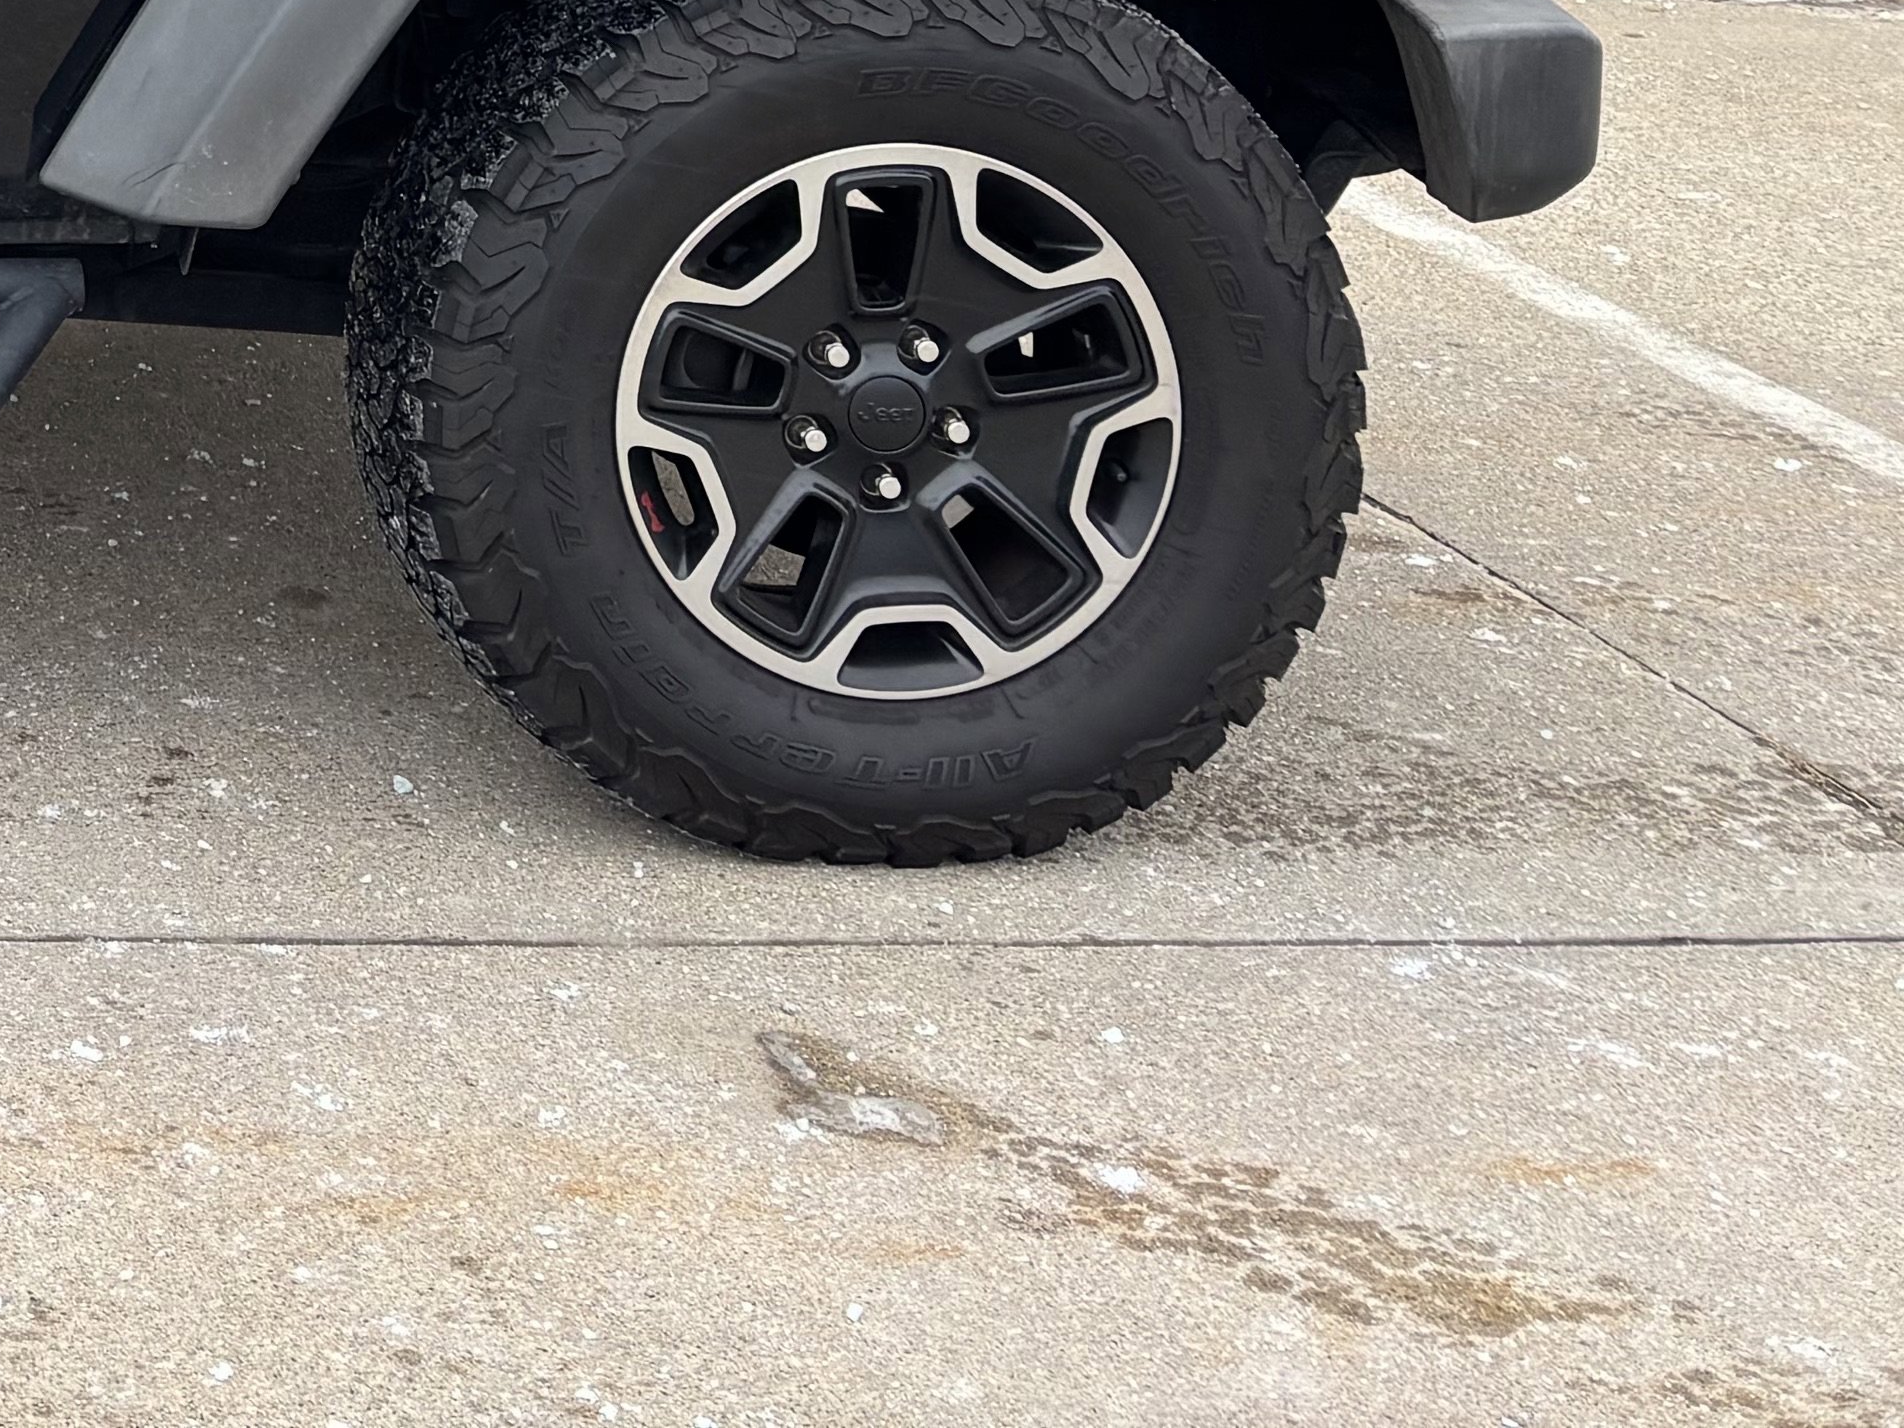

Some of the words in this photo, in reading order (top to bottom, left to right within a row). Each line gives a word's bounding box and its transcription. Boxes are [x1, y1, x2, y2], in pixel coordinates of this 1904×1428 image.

[853, 66, 1268, 367] BFGoodrich
[541, 424, 580, 558] T/A
[589, 591, 1039, 794] All-Terrain
